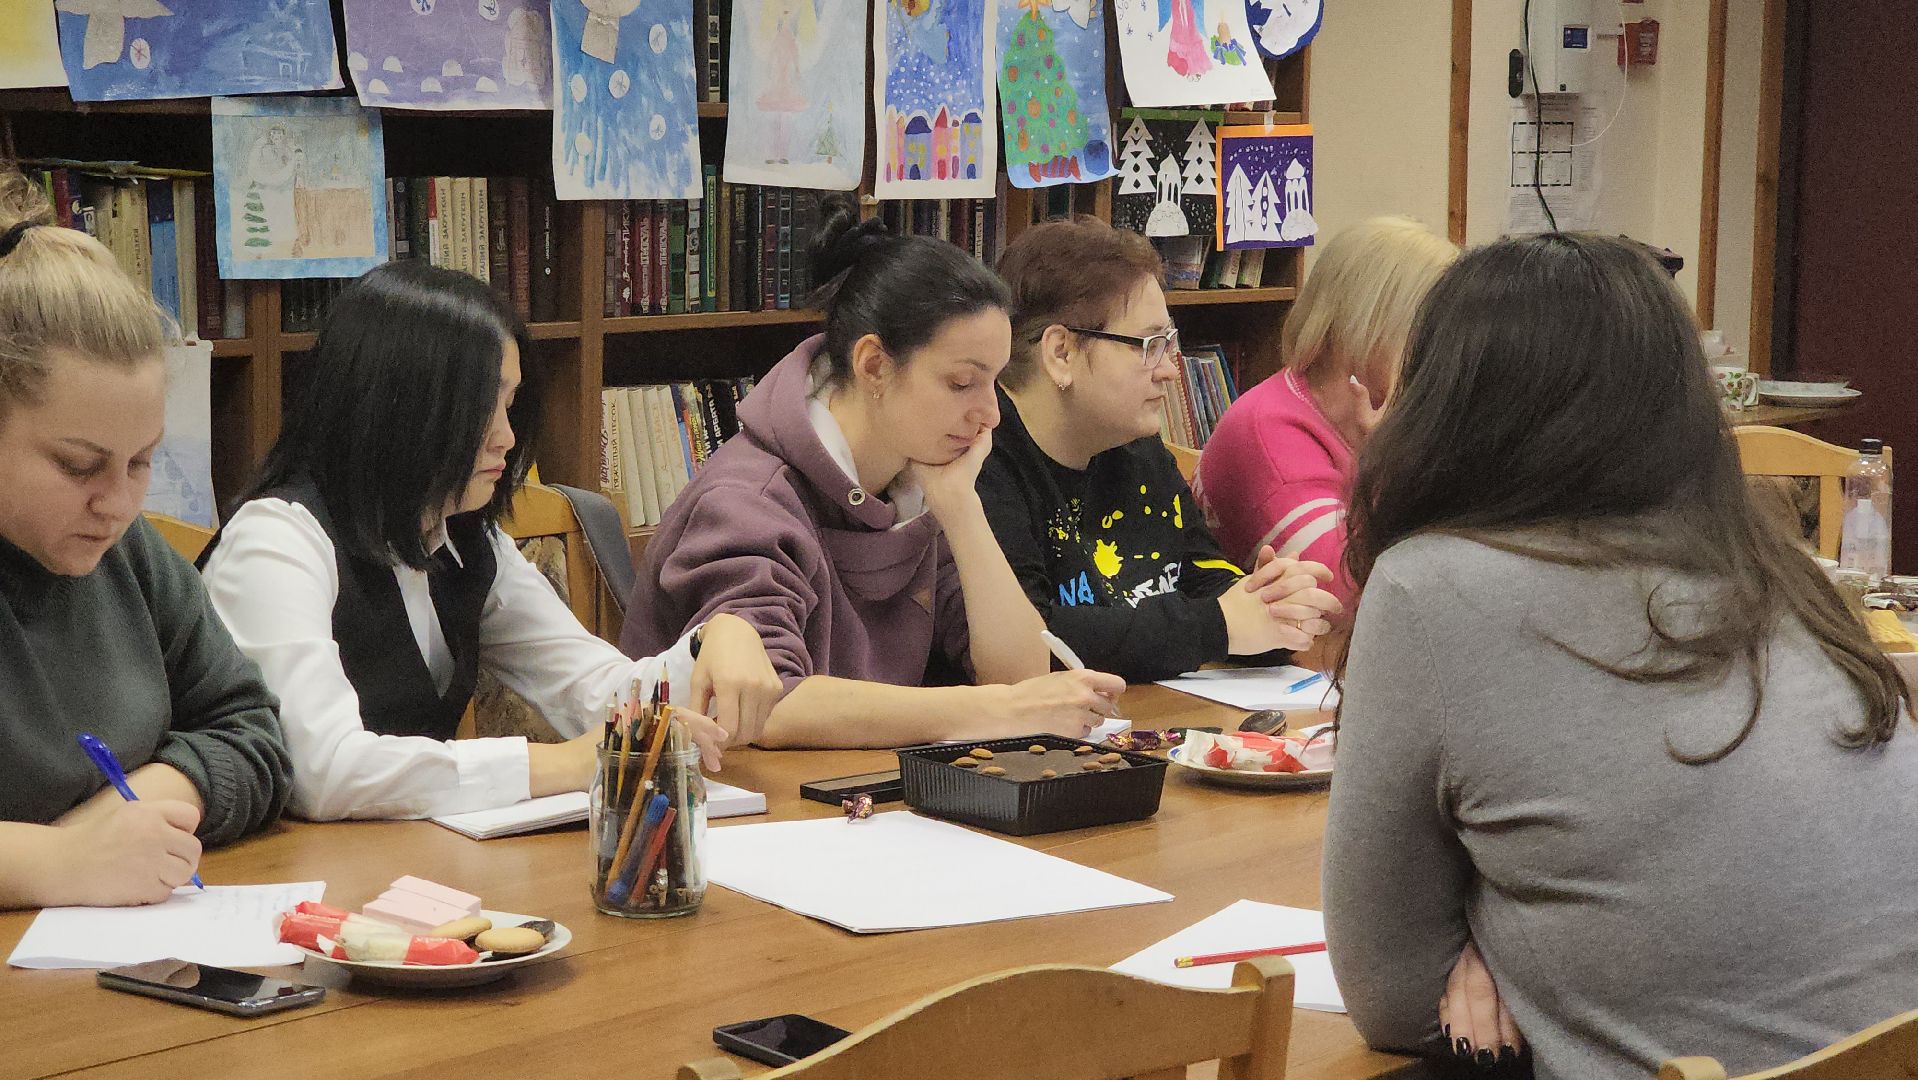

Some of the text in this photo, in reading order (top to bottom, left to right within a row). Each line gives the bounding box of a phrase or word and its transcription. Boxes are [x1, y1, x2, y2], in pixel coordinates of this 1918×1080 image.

[440, 188, 449, 240] ЗАКРУТКИН
[478, 244, 487, 283] ИТАЛИЙ
[708, 399, 722, 438] АРБАТА
